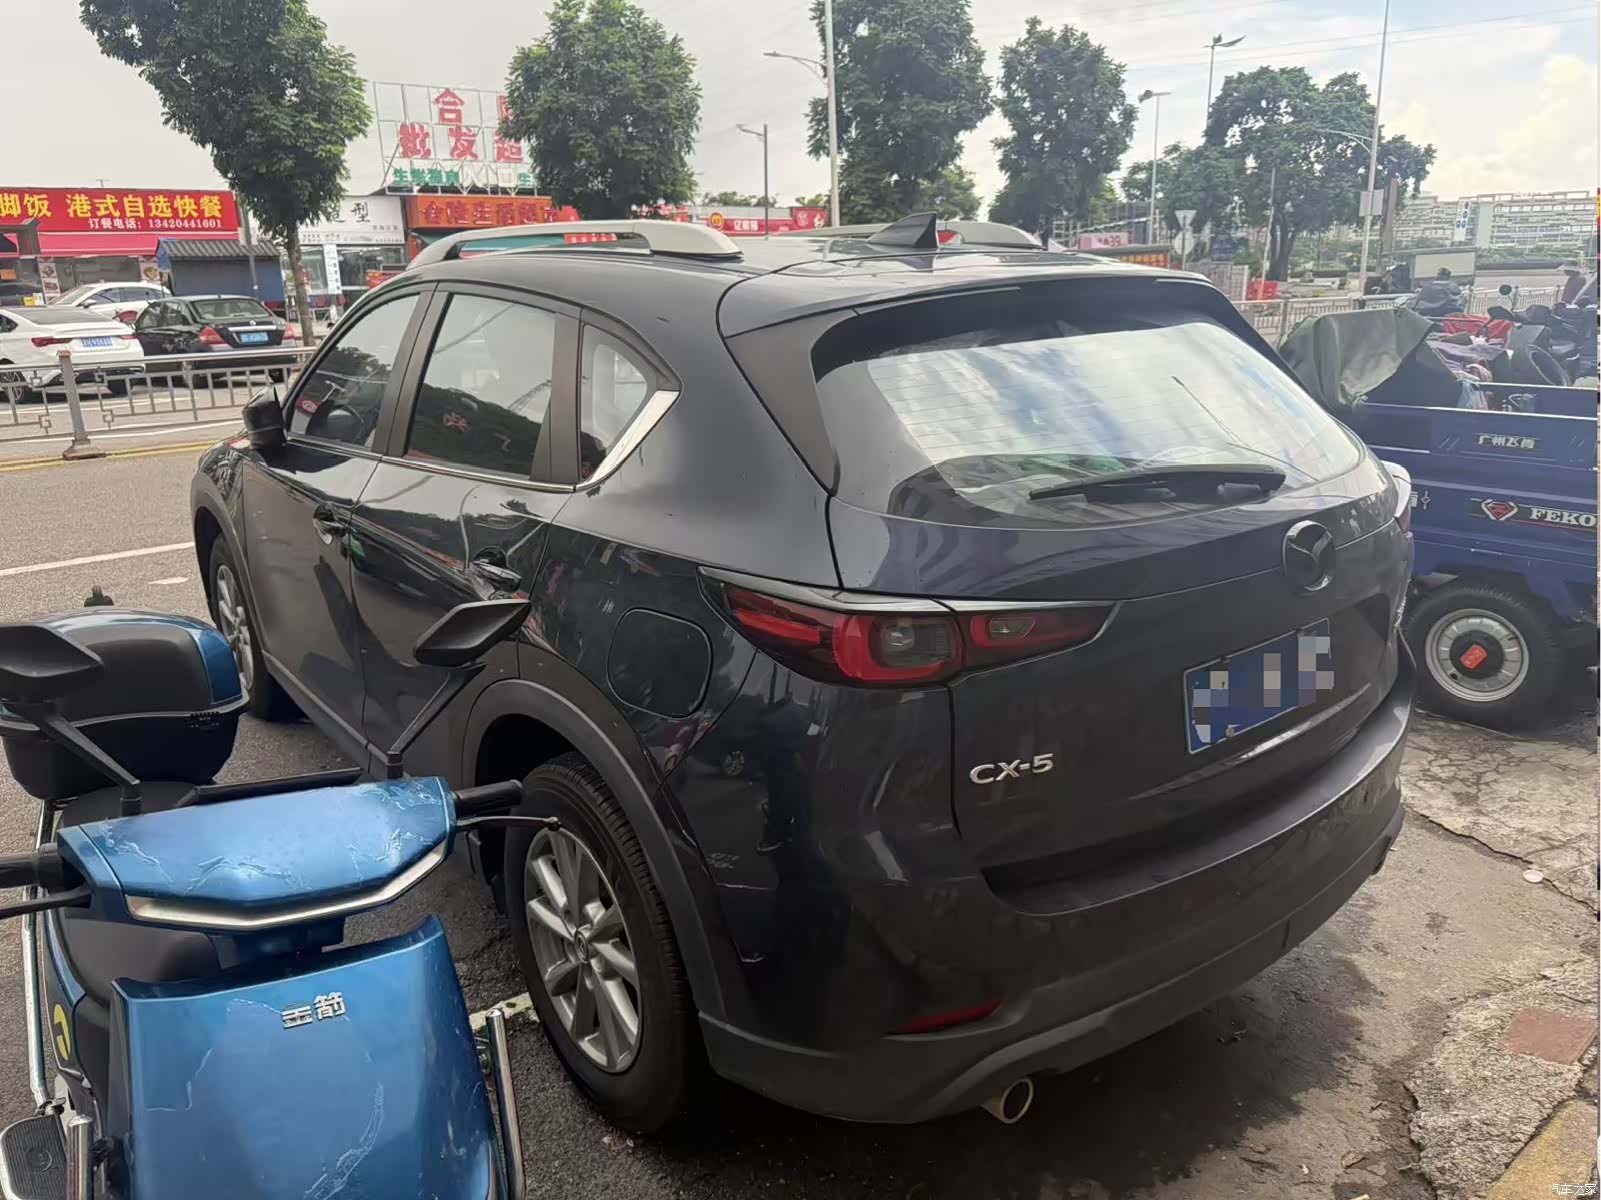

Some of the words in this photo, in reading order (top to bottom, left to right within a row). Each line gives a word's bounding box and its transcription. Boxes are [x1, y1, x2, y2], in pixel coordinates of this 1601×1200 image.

[66, 194, 222, 218] 港式自选快餐
[969, 753, 1054, 784] CX-5
